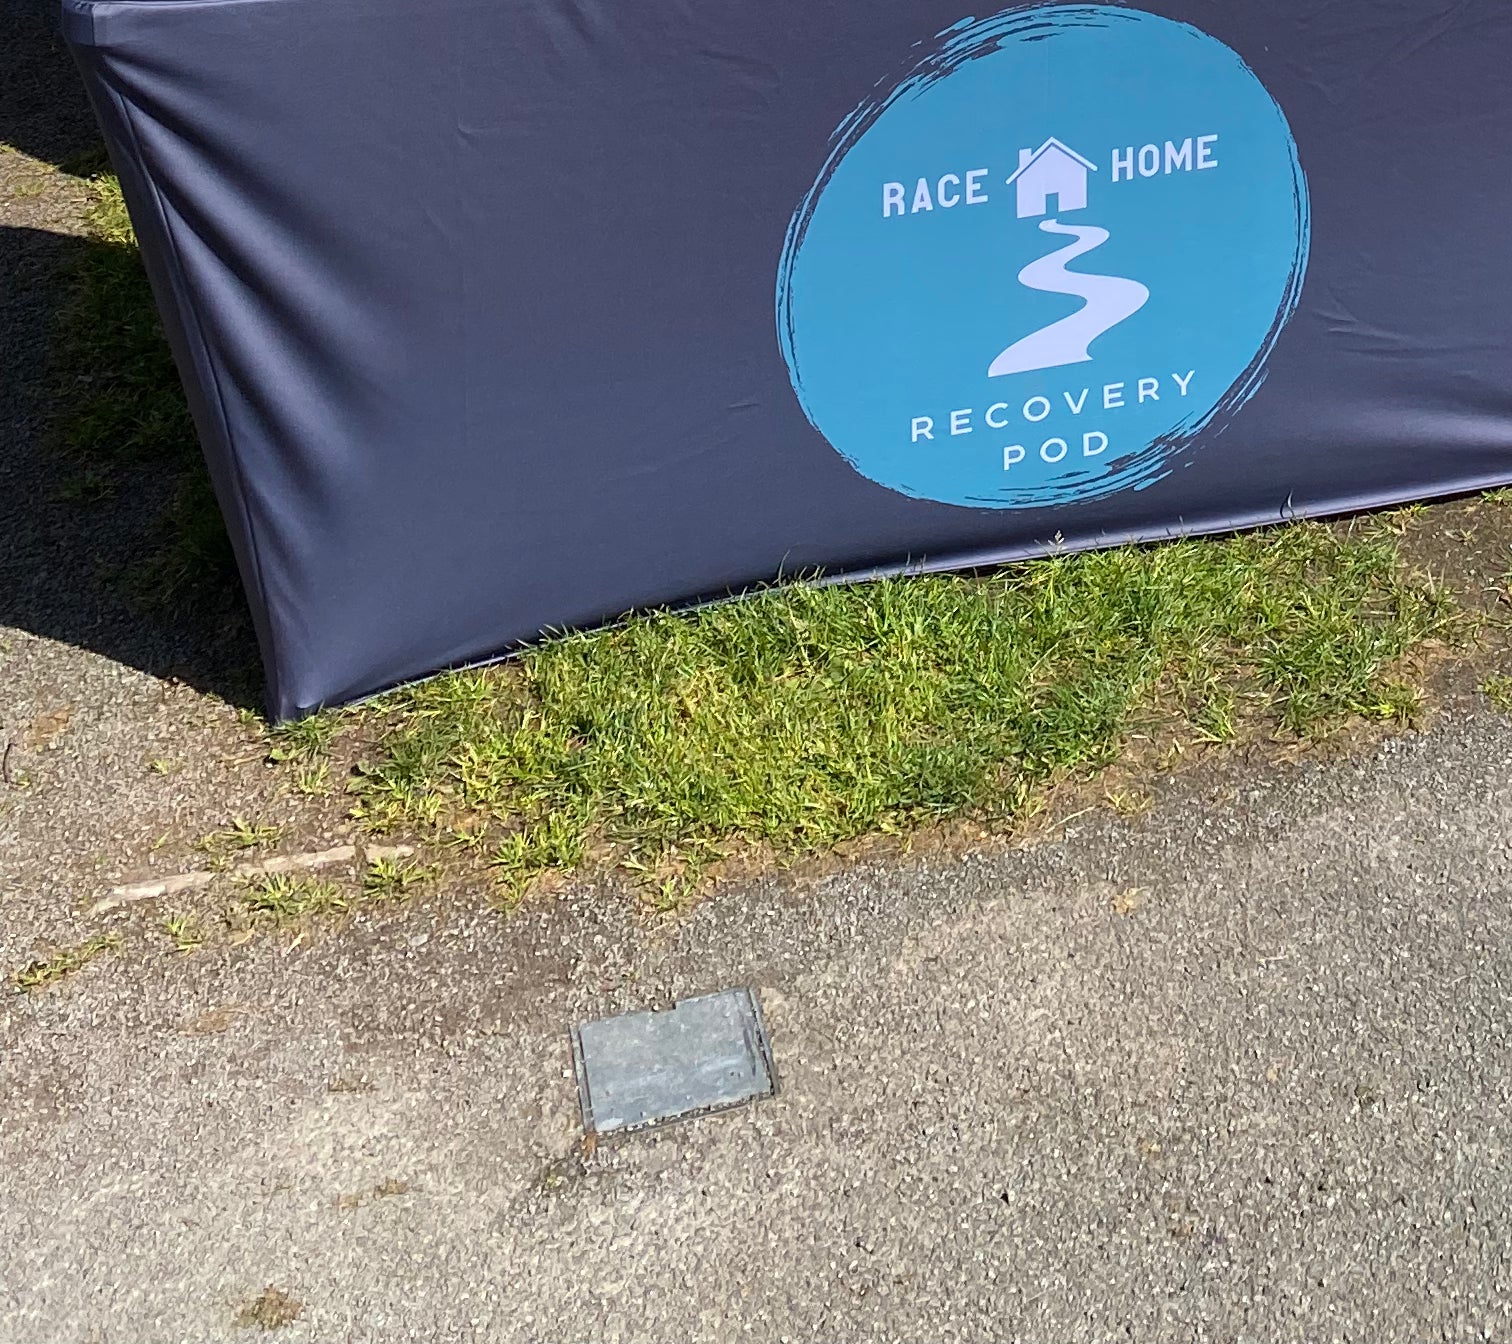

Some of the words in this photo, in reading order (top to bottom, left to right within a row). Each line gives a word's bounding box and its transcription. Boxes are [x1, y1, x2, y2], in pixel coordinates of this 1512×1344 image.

[883, 169, 989, 218] RACE
[1111, 134, 1218, 182] HOME
[911, 370, 1196, 443] RECOVERY
[1003, 431, 1109, 471] POD
